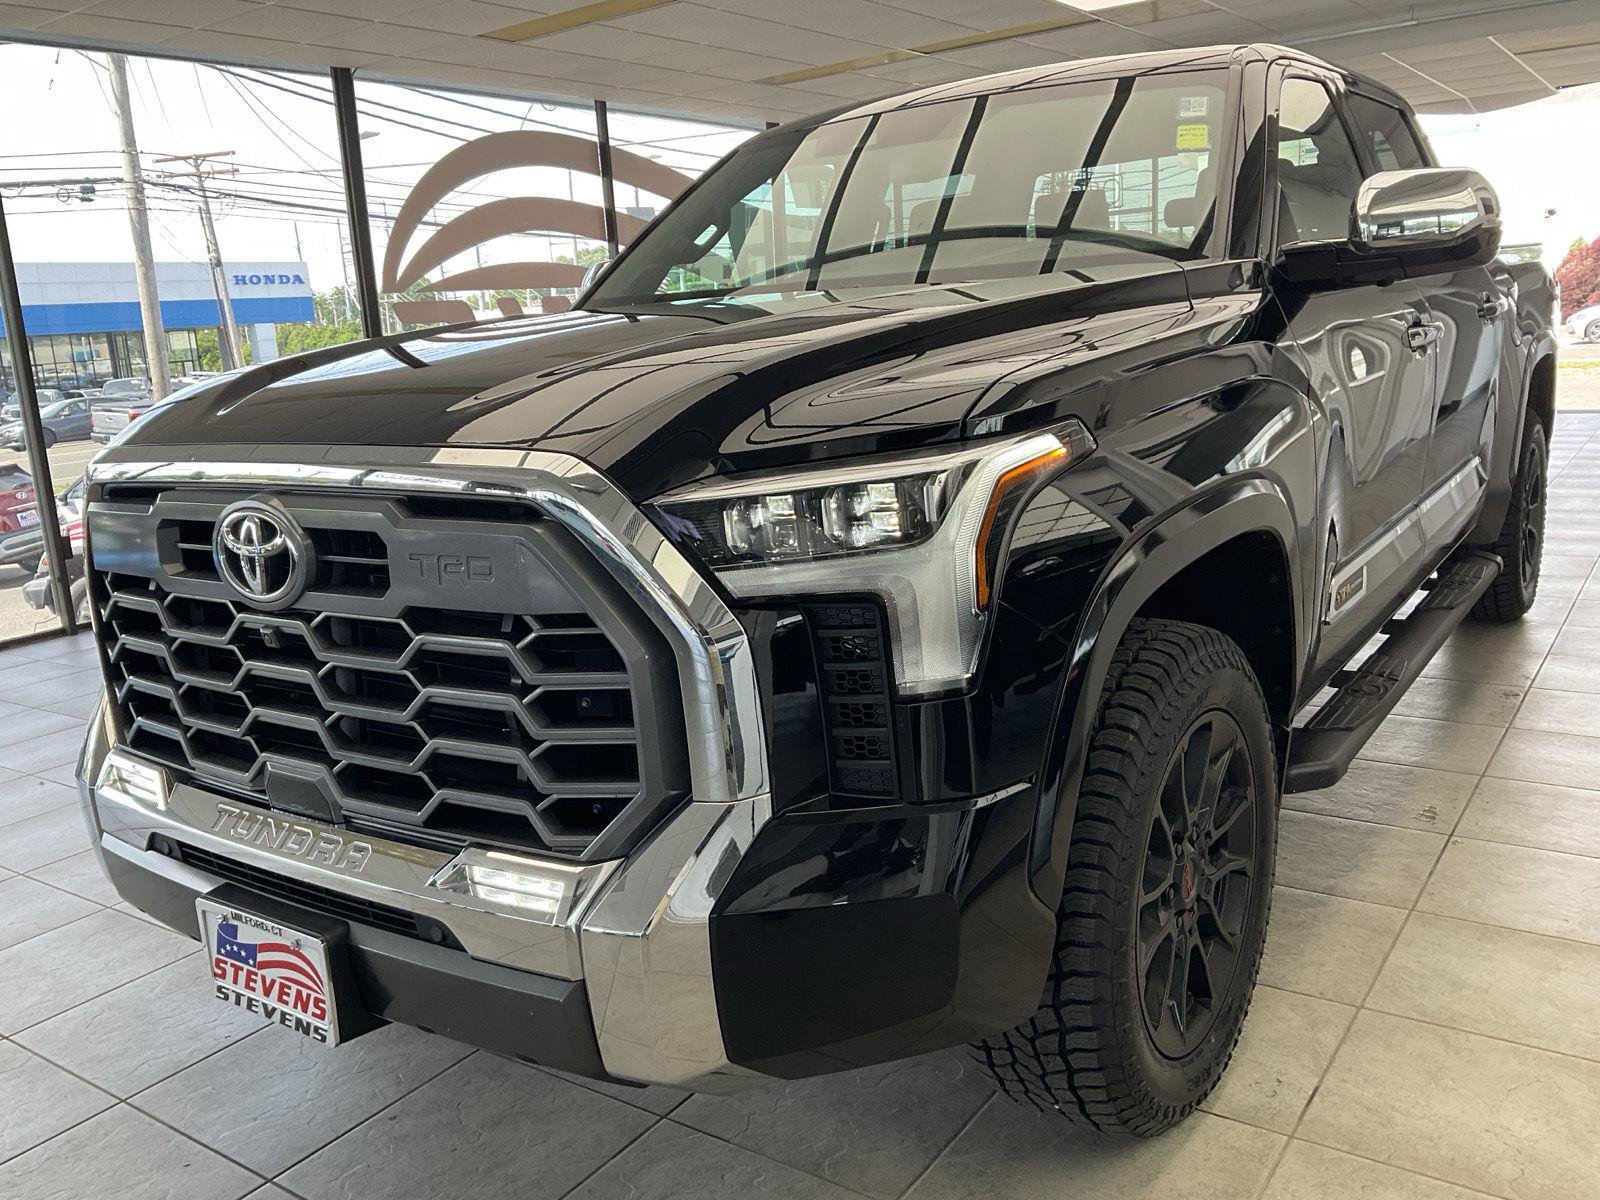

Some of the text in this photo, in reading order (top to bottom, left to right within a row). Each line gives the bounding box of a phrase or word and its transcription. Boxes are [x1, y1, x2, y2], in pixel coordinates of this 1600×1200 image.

[233, 274, 305, 285] HONDA
[408, 552, 495, 586] TRD
[211, 803, 372, 872] TUNDRA
[271, 926, 283, 937] CT
[213, 956, 326, 1022] STEVENS
[215, 984, 328, 1043] STEVENS
